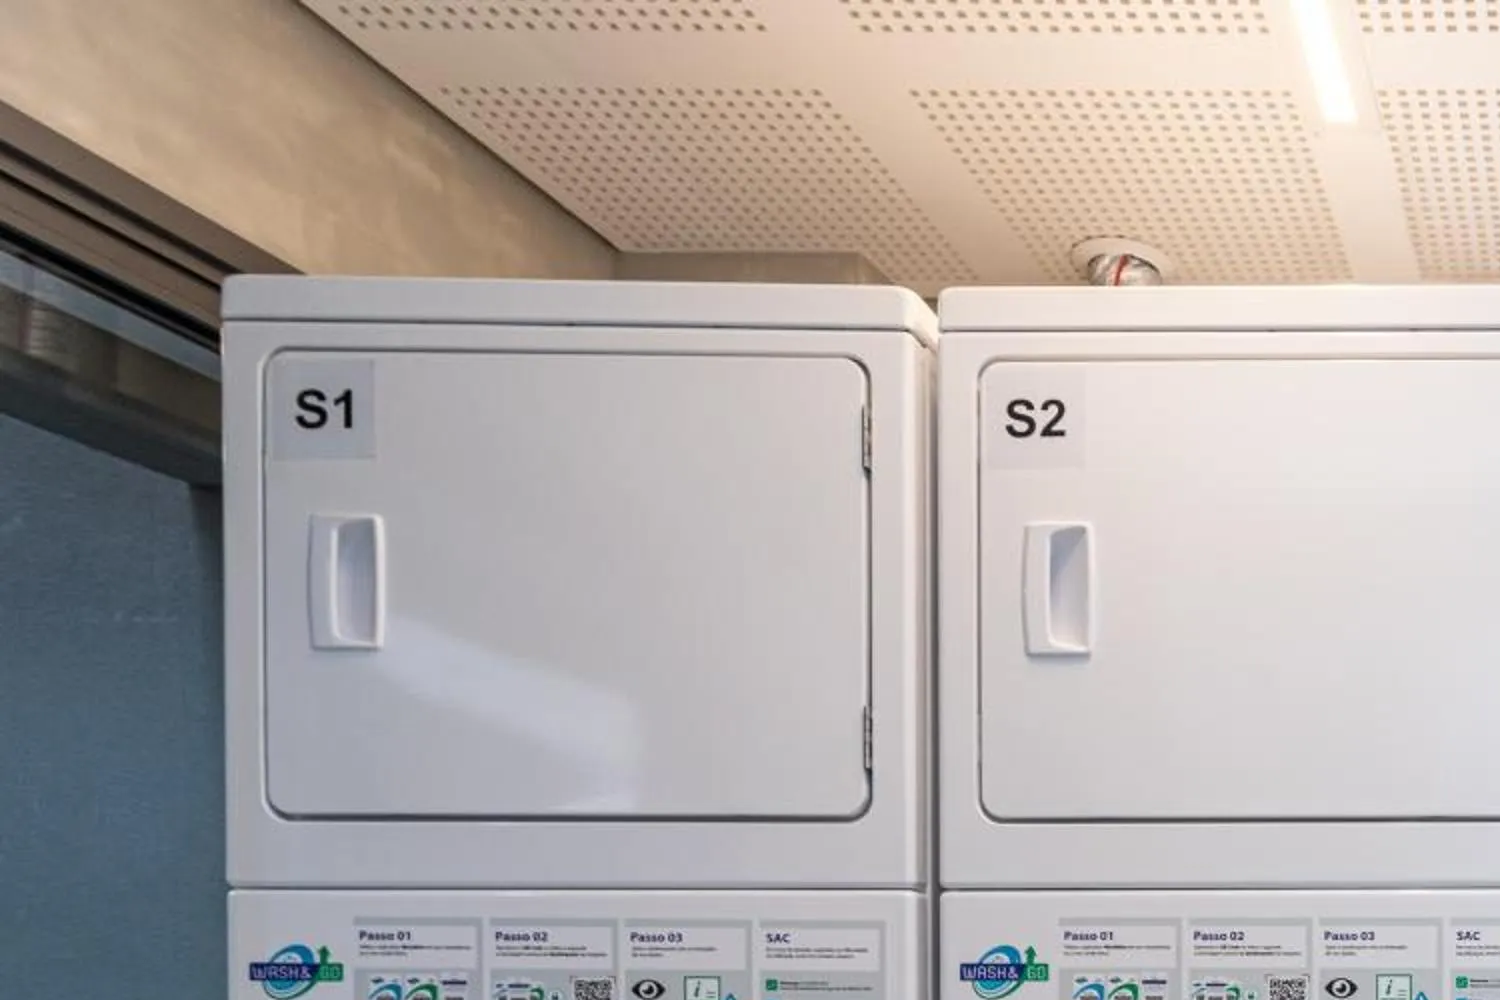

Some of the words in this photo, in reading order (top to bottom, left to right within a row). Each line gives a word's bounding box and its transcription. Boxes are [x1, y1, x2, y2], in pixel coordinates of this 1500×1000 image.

[294, 387, 353, 430] S1
[1005, 398, 1066, 438] S2
[359, 930, 395, 941] Passo
[397, 930, 412, 941] 01
[495, 931, 530, 942] Passo
[532, 931, 548, 942] 02
[630, 932, 665, 943] Passo
[667, 932, 683, 943] 03
[766, 932, 790, 944] SAC
[1064, 930, 1097, 941] Passo
[1099, 930, 1114, 941] 01
[1193, 930, 1227, 942] Passo
[1229, 930, 1245, 942] 02
[1324, 930, 1358, 942] Passo
[1360, 930, 1375, 942] 03
[1456, 930, 1480, 941] SAC
